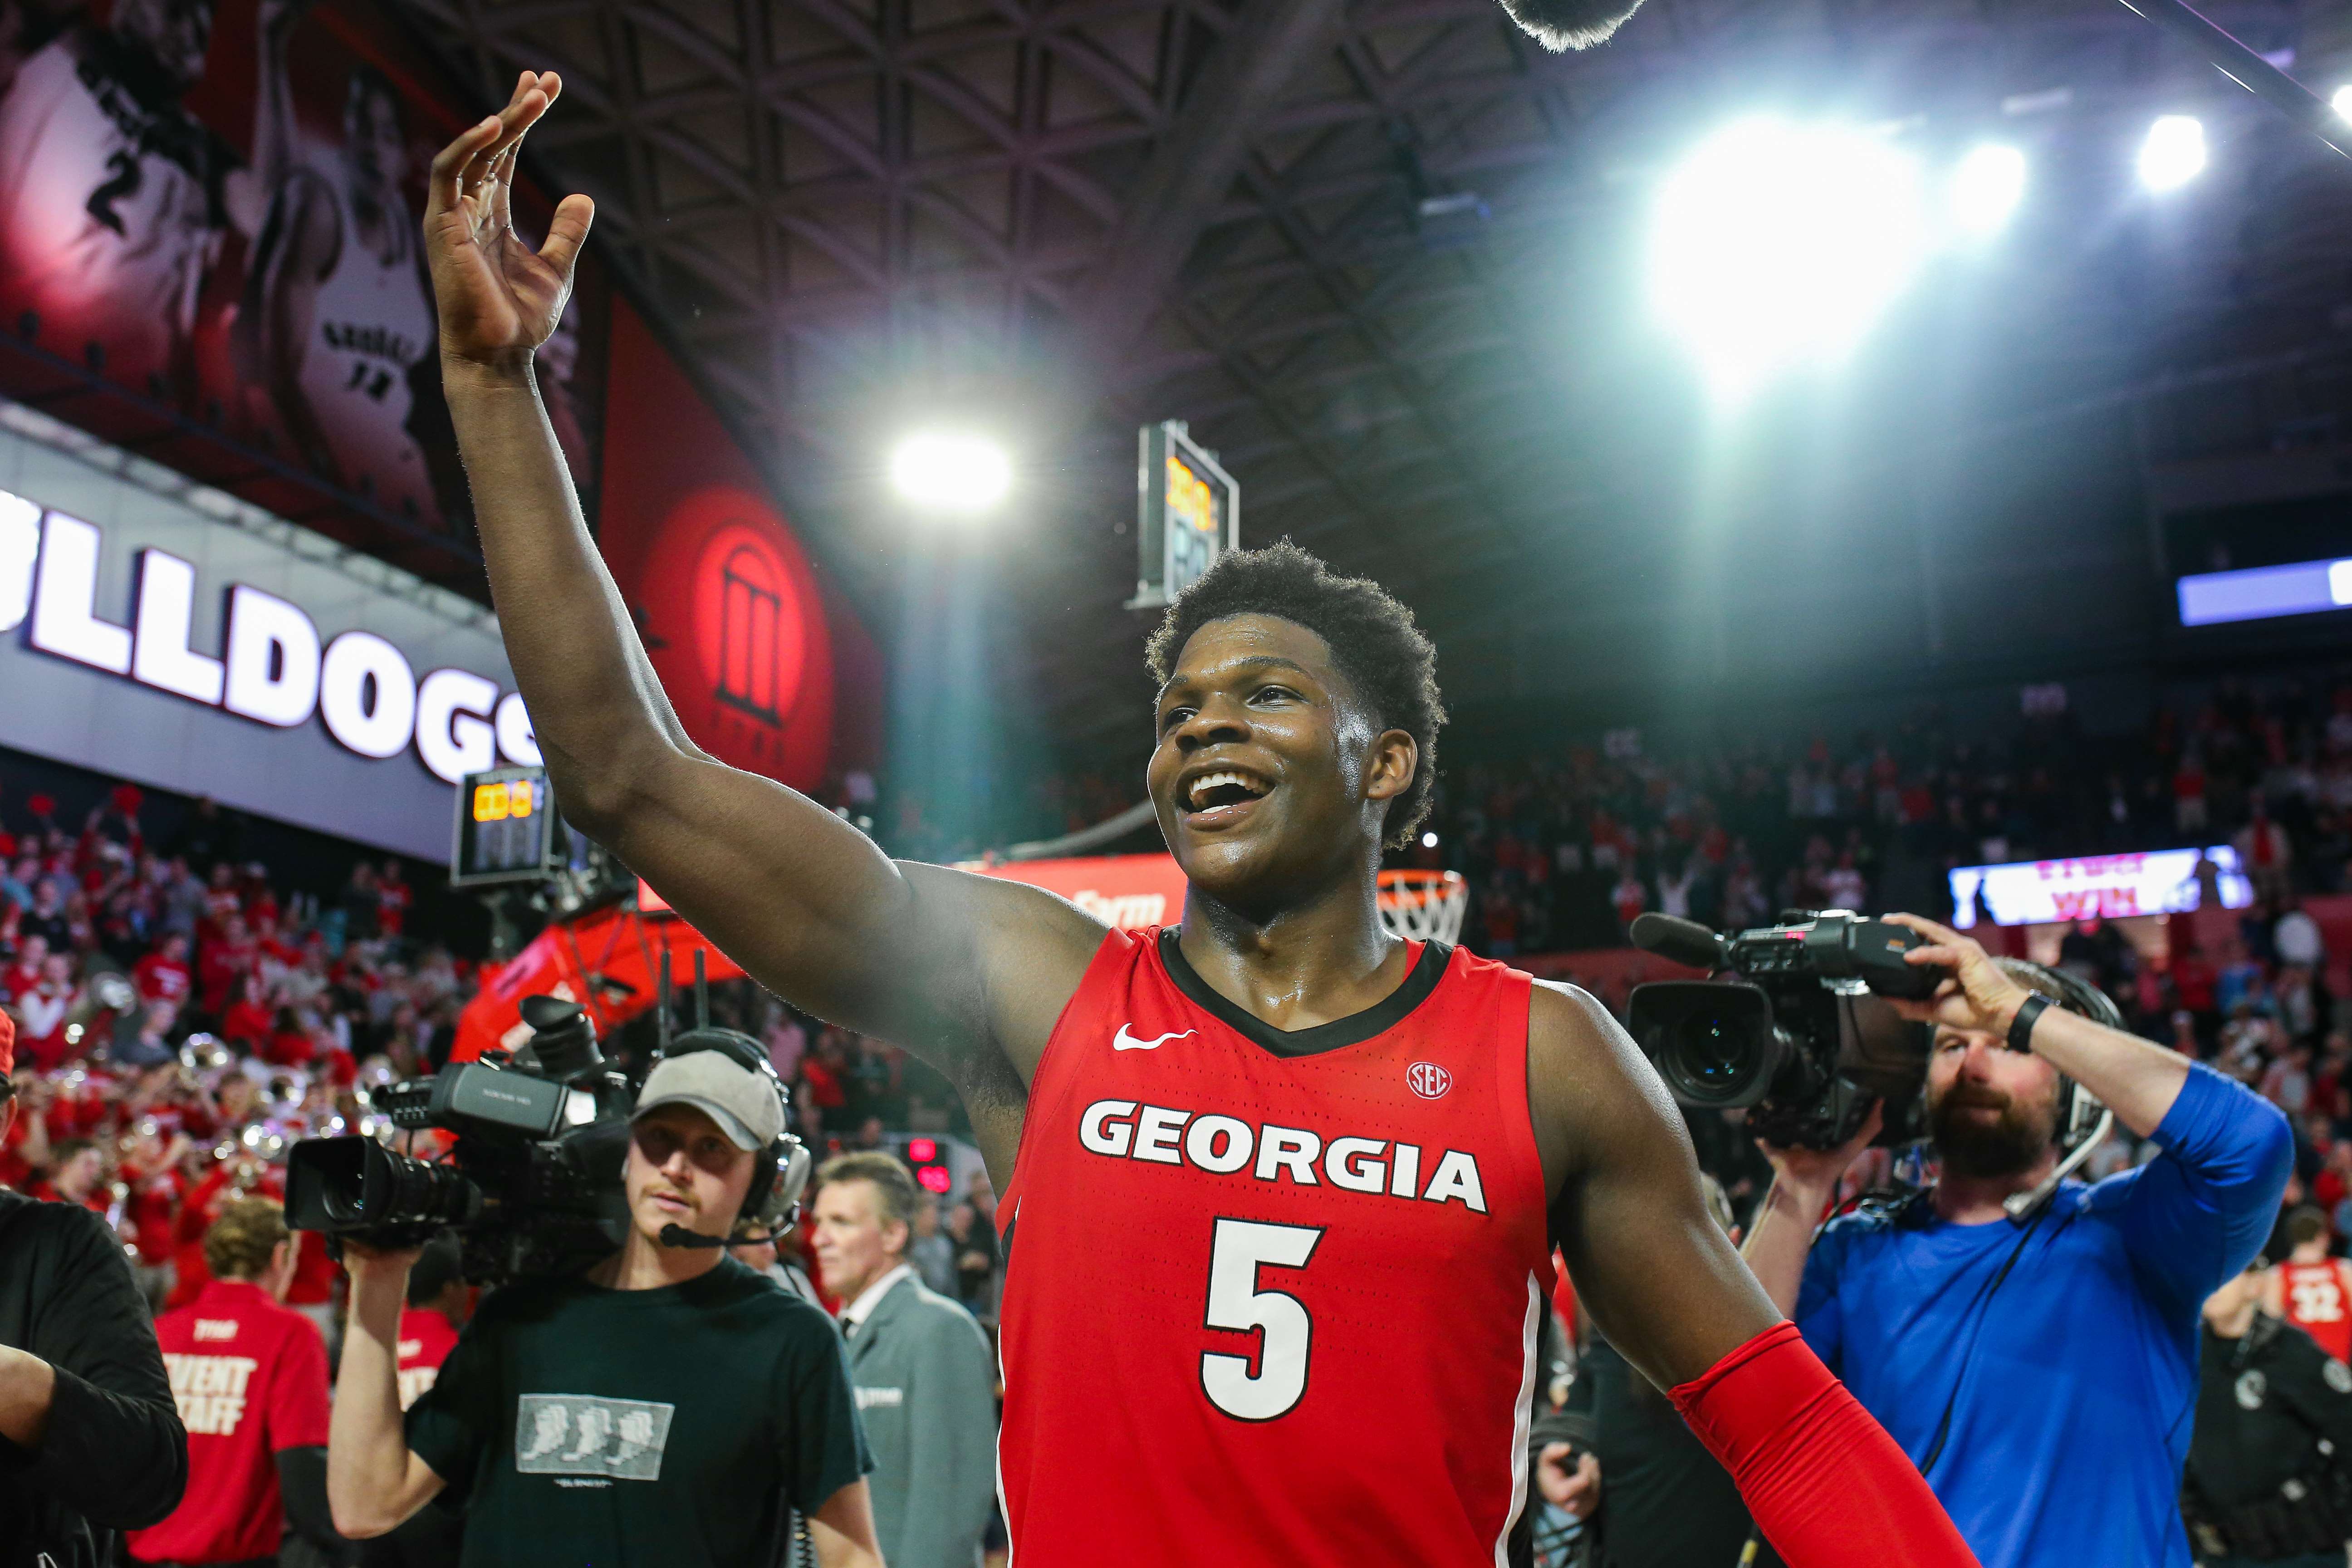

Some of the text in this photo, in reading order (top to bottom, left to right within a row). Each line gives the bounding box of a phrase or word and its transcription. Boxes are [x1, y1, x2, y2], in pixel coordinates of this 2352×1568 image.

[1411, 1063, 1447, 1095] SEC
[1079, 1099, 1490, 1215] GEORGIA
[1199, 1216, 1327, 1423] 5
[172, 1396, 247, 1436] TAFF
